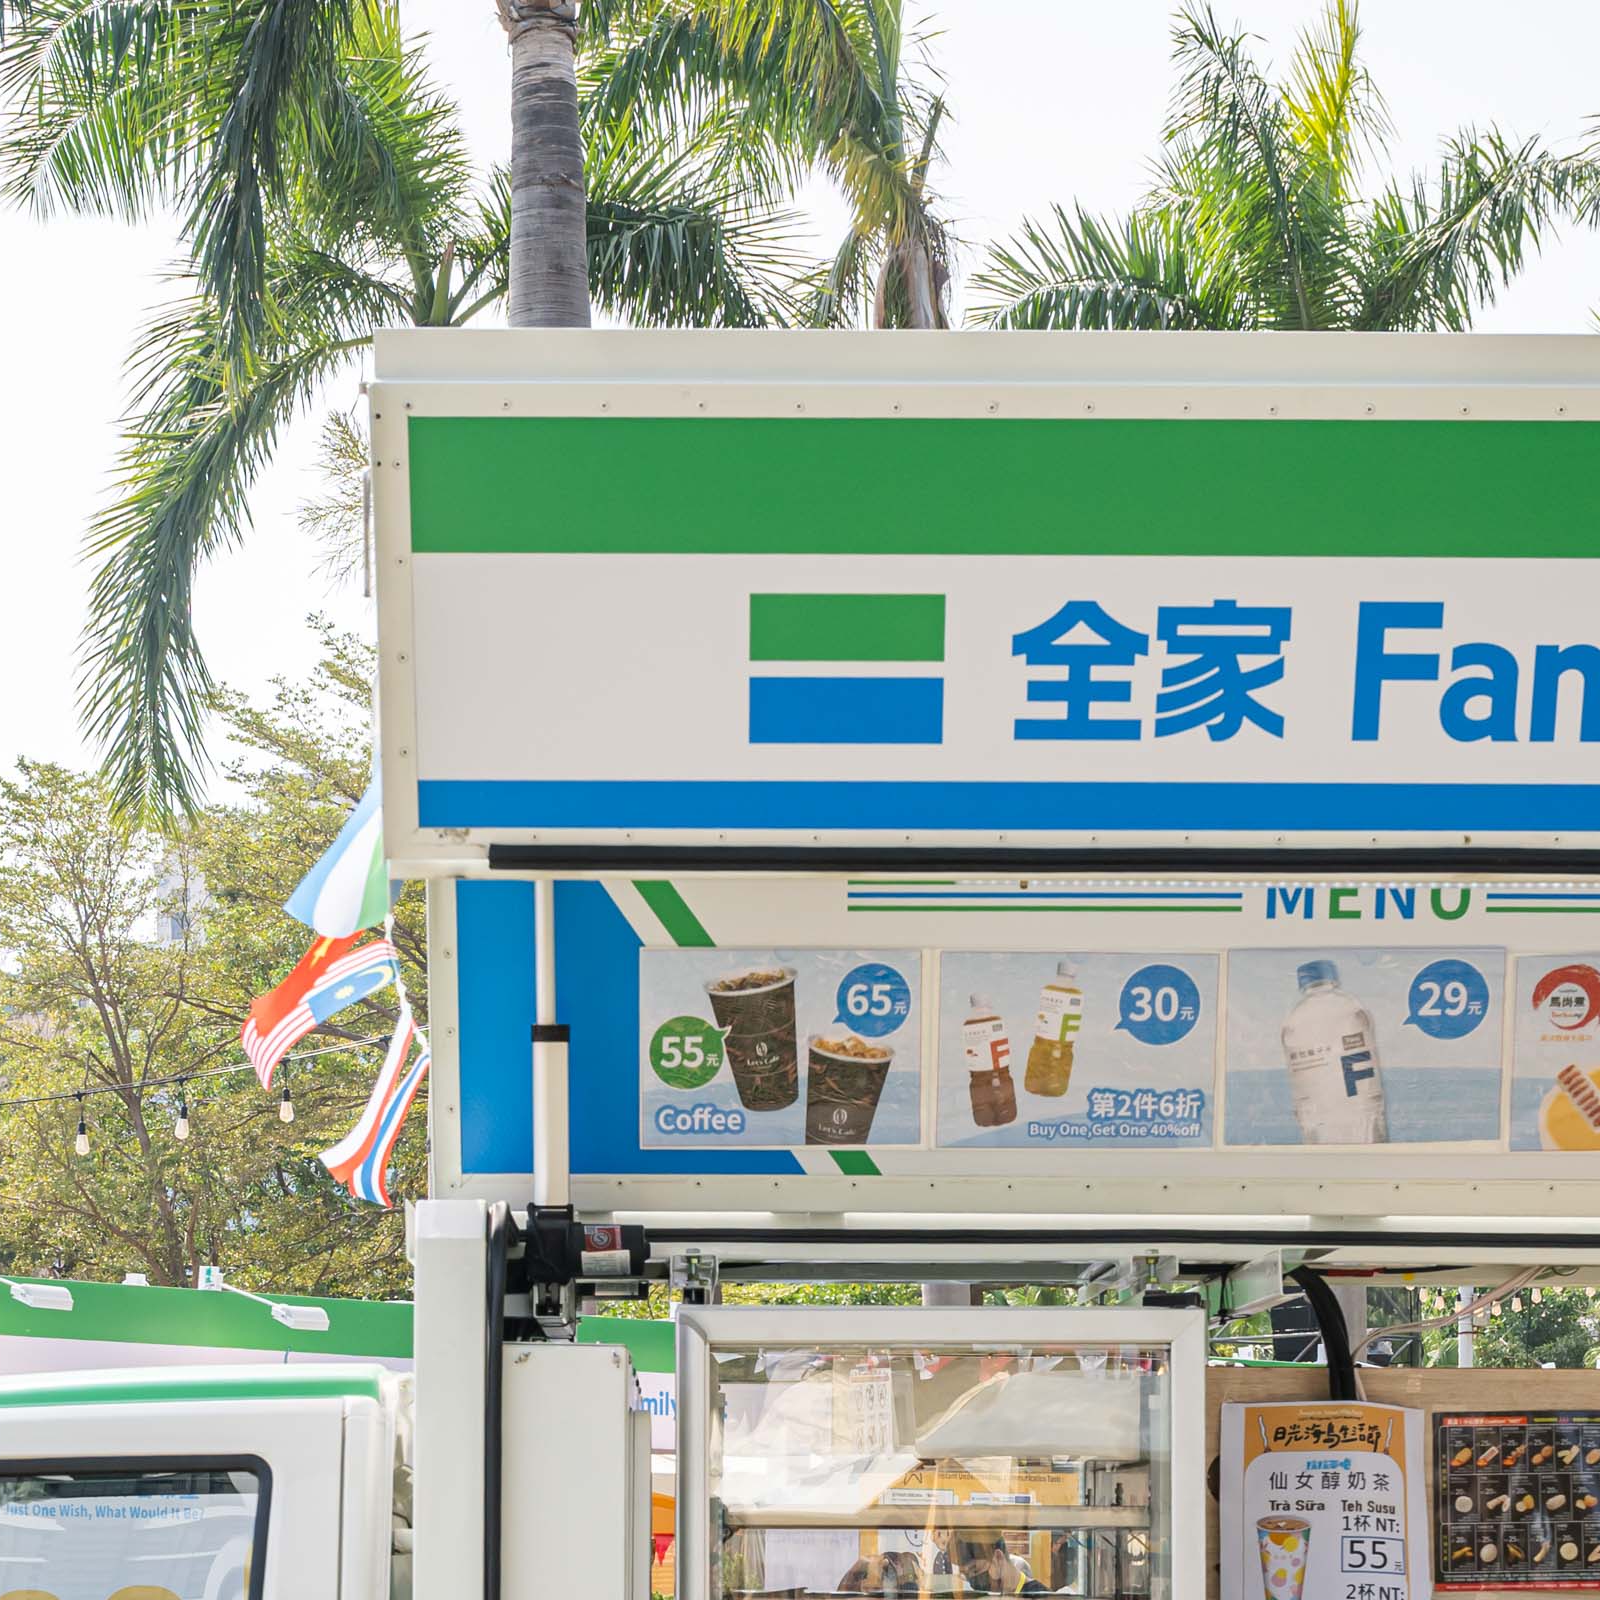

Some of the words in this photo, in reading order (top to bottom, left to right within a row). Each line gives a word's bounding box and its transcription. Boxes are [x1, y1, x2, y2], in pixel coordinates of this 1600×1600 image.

[1011, 599, 1291, 742] 全家
[846, 984, 907, 1016] 65元
[1128, 986, 1194, 1022] 30元
[1418, 982, 1482, 1016] 29元
[660, 1036, 720, 1068] 55元
[1091, 1091, 1201, 1119] 第2件6折
[658, 1106, 742, 1131] Coffee
[1030, 1123, 1056, 1138] Buy
[1119, 1123, 1147, 1136] One
[1150, 1123, 1200, 1137] 40%off
[1269, 1471, 1390, 1492] 仙女醇奶茶
[32, 1505, 56, 1517] One
[59, 1504, 93, 1520] Wish,
[95, 1505, 127, 1519] What
[130, 1505, 167, 1519] Would
[1269, 1500, 1291, 1511] Trà
[1341, 1500, 1363, 1512] Teh
[1367, 1502, 1396, 1514] Susu
[1342, 1515, 1370, 1532] 1杯
[1376, 1519, 1400, 1533] NT:
[1348, 1541, 1388, 1569] 55
[1346, 1584, 1375, 1600] 2杯
[1379, 1586, 1404, 1600] NT:
